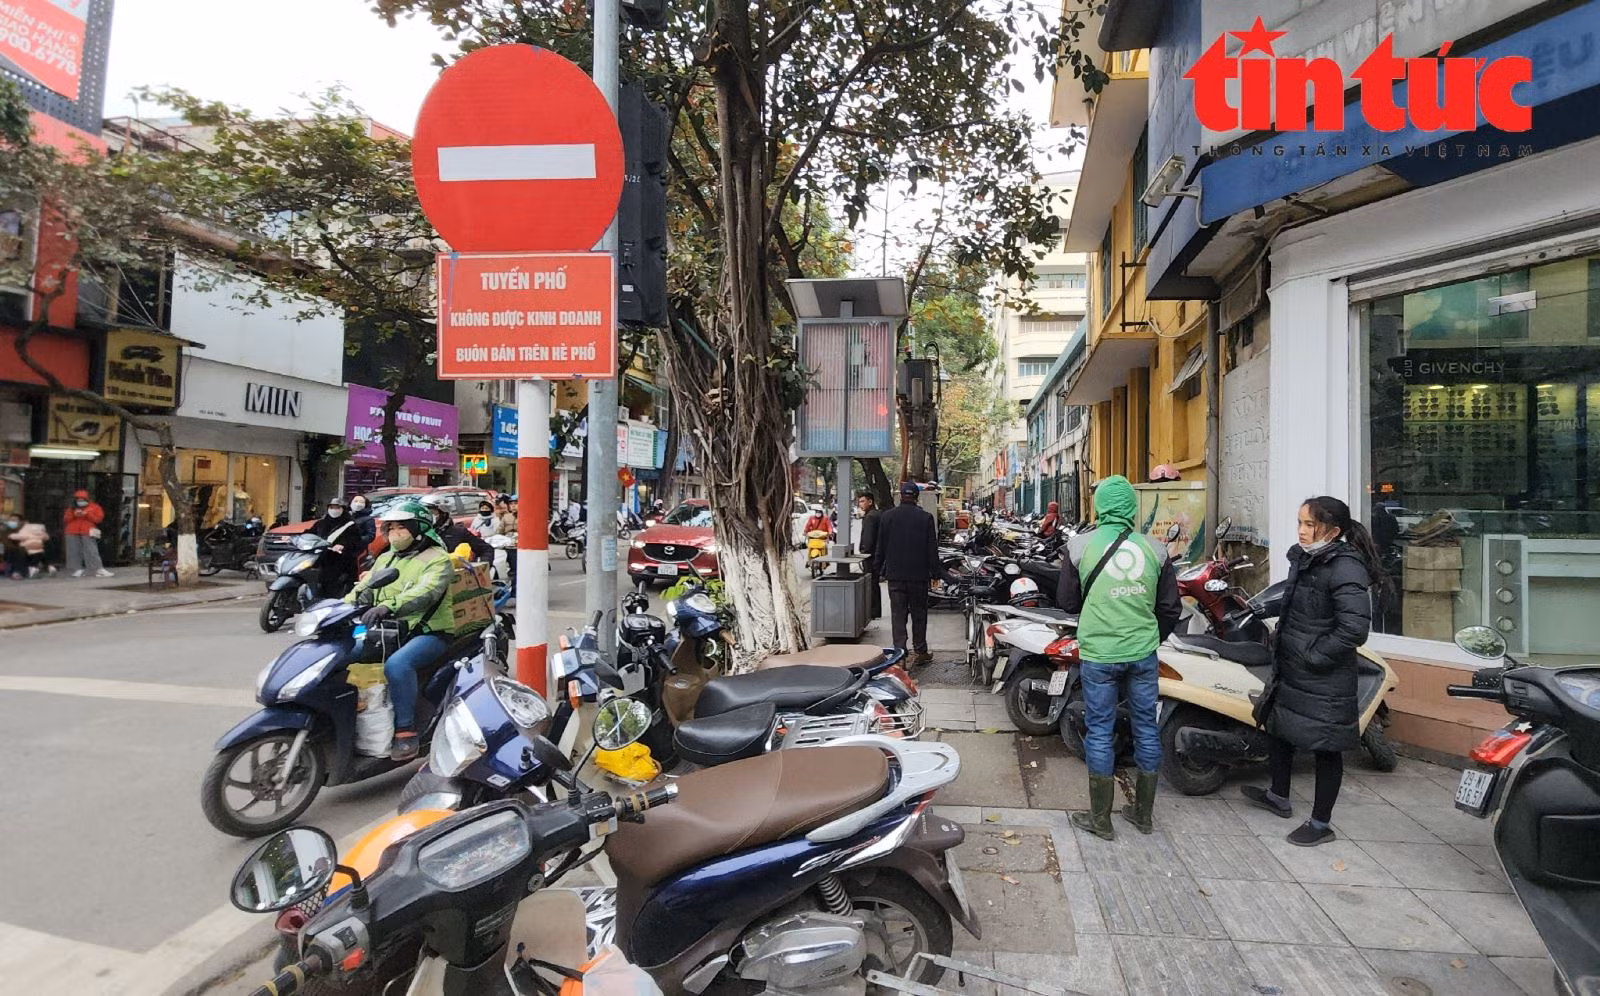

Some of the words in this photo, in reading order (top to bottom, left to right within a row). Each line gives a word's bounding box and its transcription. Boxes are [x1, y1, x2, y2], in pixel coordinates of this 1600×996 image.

[480, 266, 529, 290] TUYẾN
[534, 265, 567, 290] PHỐ
[450, 308, 490, 327] KHÔNG
[492, 309, 525, 330] ĐƯỢC
[527, 311, 556, 326] KINH
[559, 310, 602, 326] DOANH
[456, 343, 489, 362] BUÔN
[491, 343, 516, 362] BÁN
[518, 343, 549, 361] TRÊN
[552, 342, 568, 361] HÈ
[570, 340, 597, 361] PHỐ
[1418, 362, 1505, 375] GIVENCHY
[245, 382, 303, 418] MIIN
[1110, 584, 1147, 599] gojek
